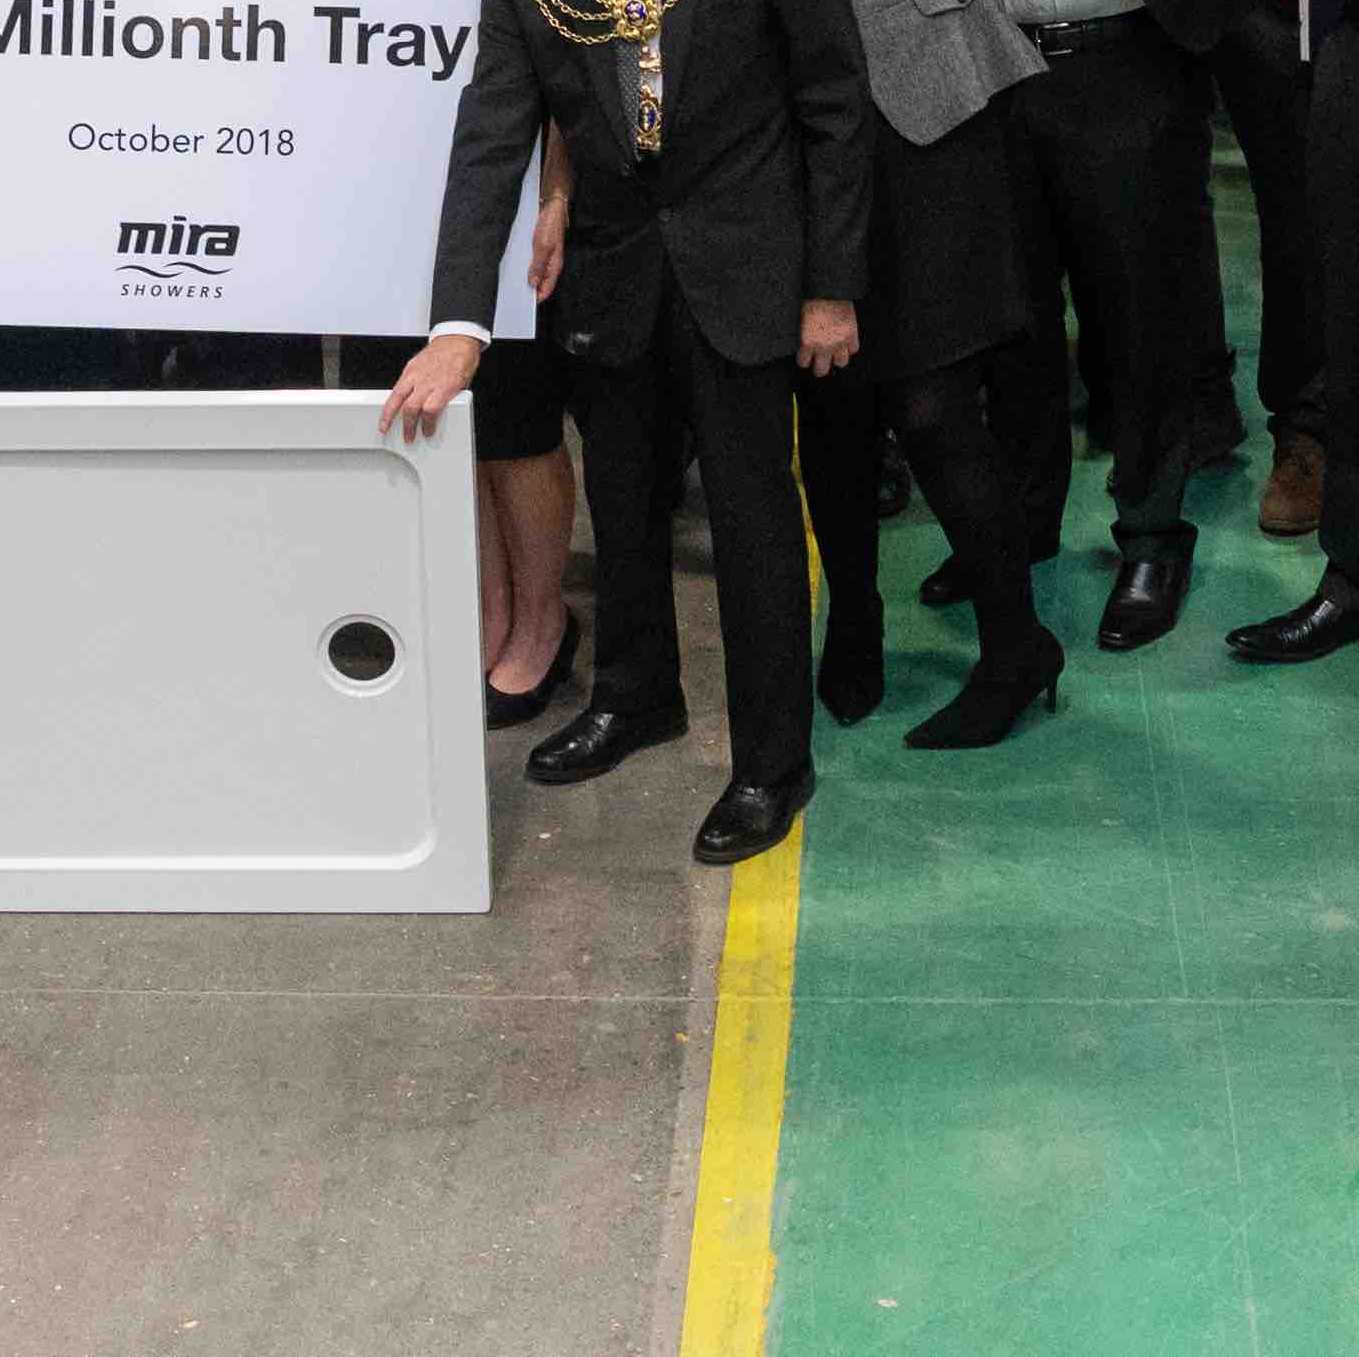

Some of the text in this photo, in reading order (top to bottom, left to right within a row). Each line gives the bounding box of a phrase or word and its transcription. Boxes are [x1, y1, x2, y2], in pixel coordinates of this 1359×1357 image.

[313, 5, 472, 82] Tray
[68, 122, 295, 157] October 2018
[116, 215, 241, 257] mira
[120, 283, 224, 300] SHOWERS
